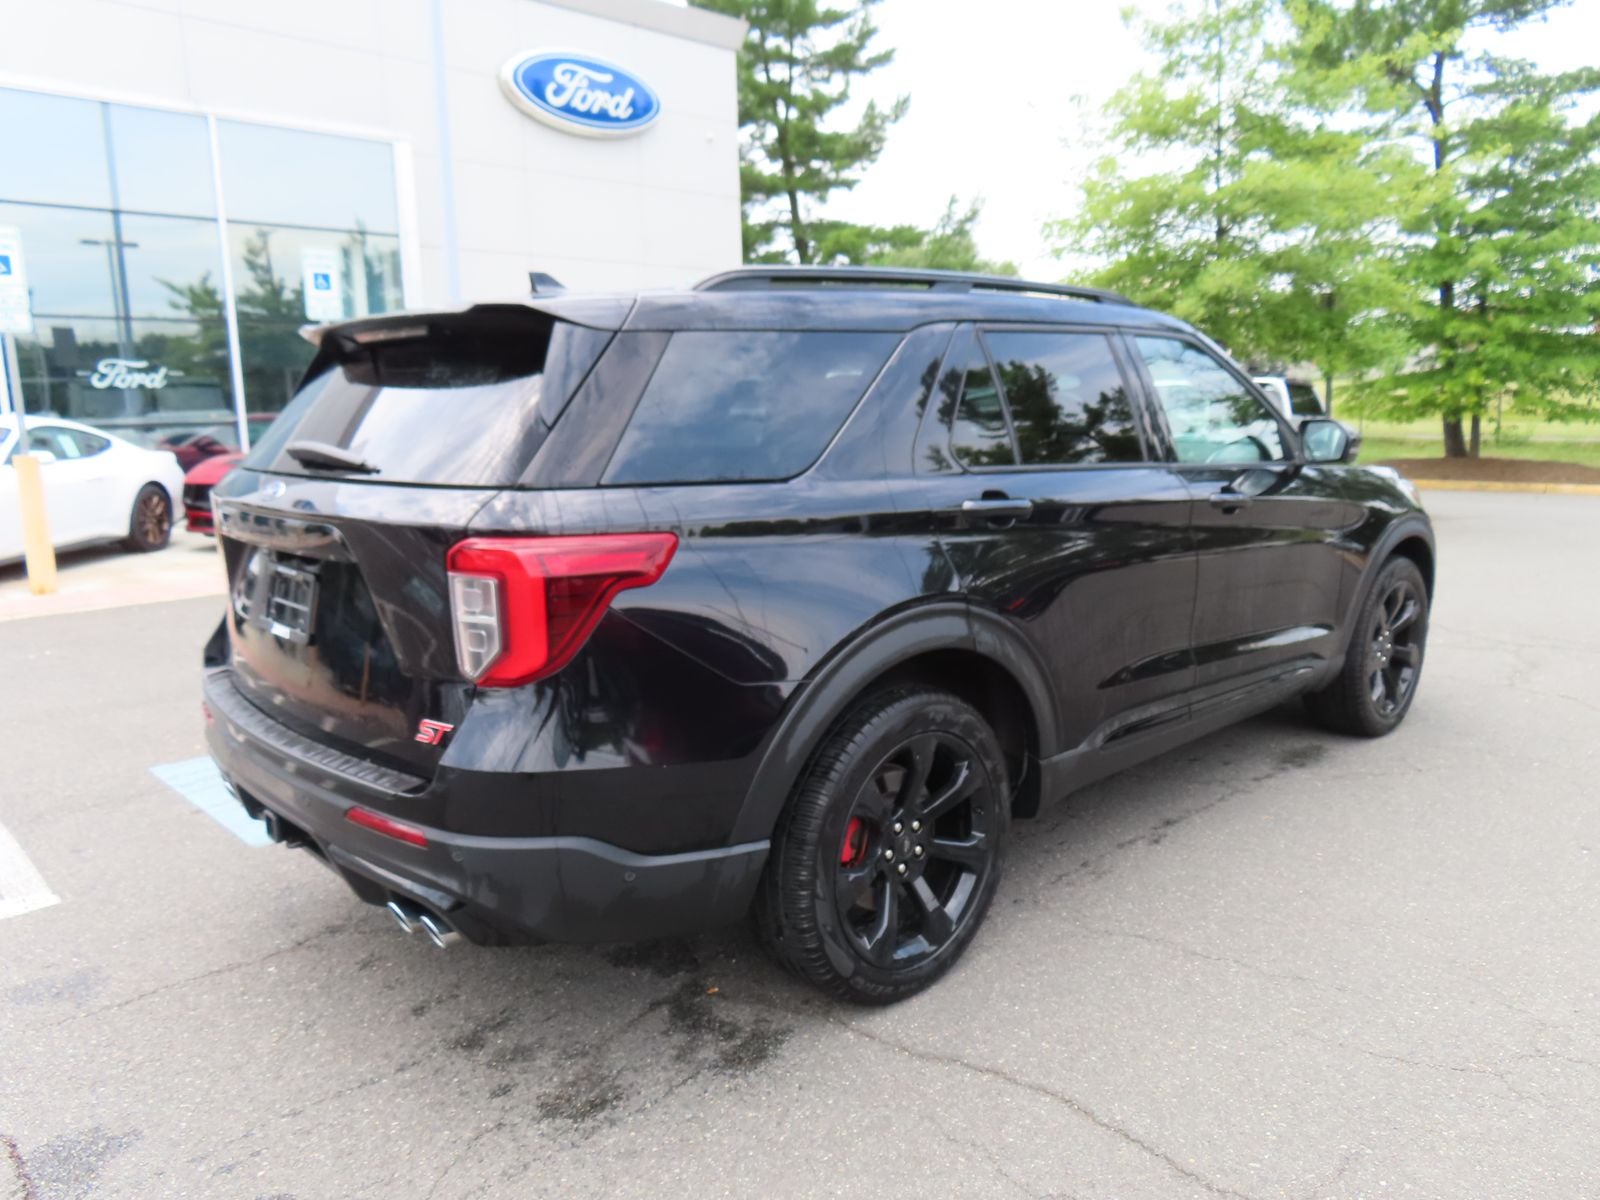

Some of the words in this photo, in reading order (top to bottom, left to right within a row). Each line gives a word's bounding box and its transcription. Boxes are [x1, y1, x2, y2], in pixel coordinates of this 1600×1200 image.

[545, 62, 634, 119] Ford
[90, 358, 168, 389] Ford
[415, 719, 455, 745] ST
